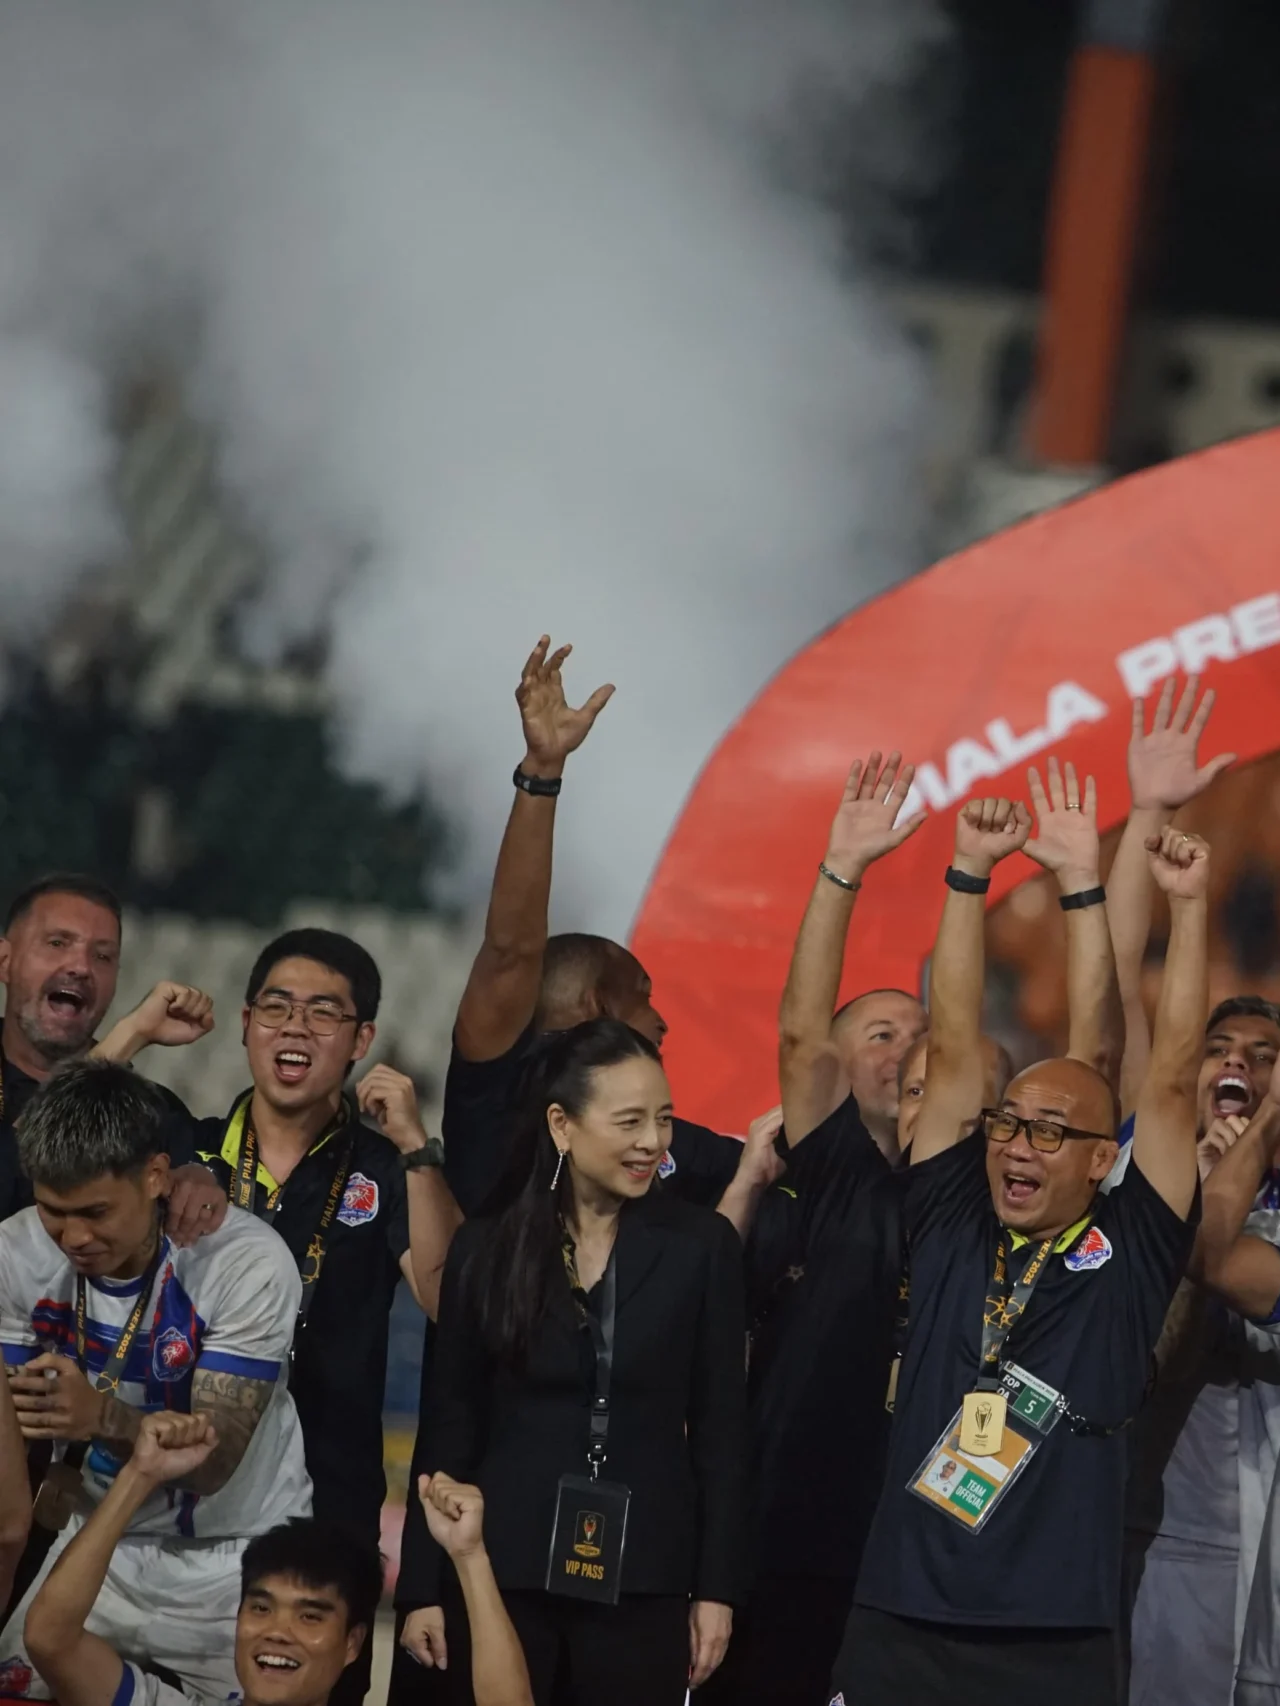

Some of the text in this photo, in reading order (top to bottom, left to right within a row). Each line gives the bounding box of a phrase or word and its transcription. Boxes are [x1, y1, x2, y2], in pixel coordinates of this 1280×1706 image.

[242, 1150, 254, 1180] PIALA
[320, 1198, 337, 1228] PIALA
[1022, 1260, 1041, 1286] 2025
[116, 1333, 133, 1359] 2025
[1002, 1373, 1021, 1390] FOP
[1024, 1399, 1038, 1414] 5
[955, 1485, 985, 1511] OFFICIAL
[966, 1478, 987, 1498] TEAM
[565, 1559, 605, 1580] VIP PASS
